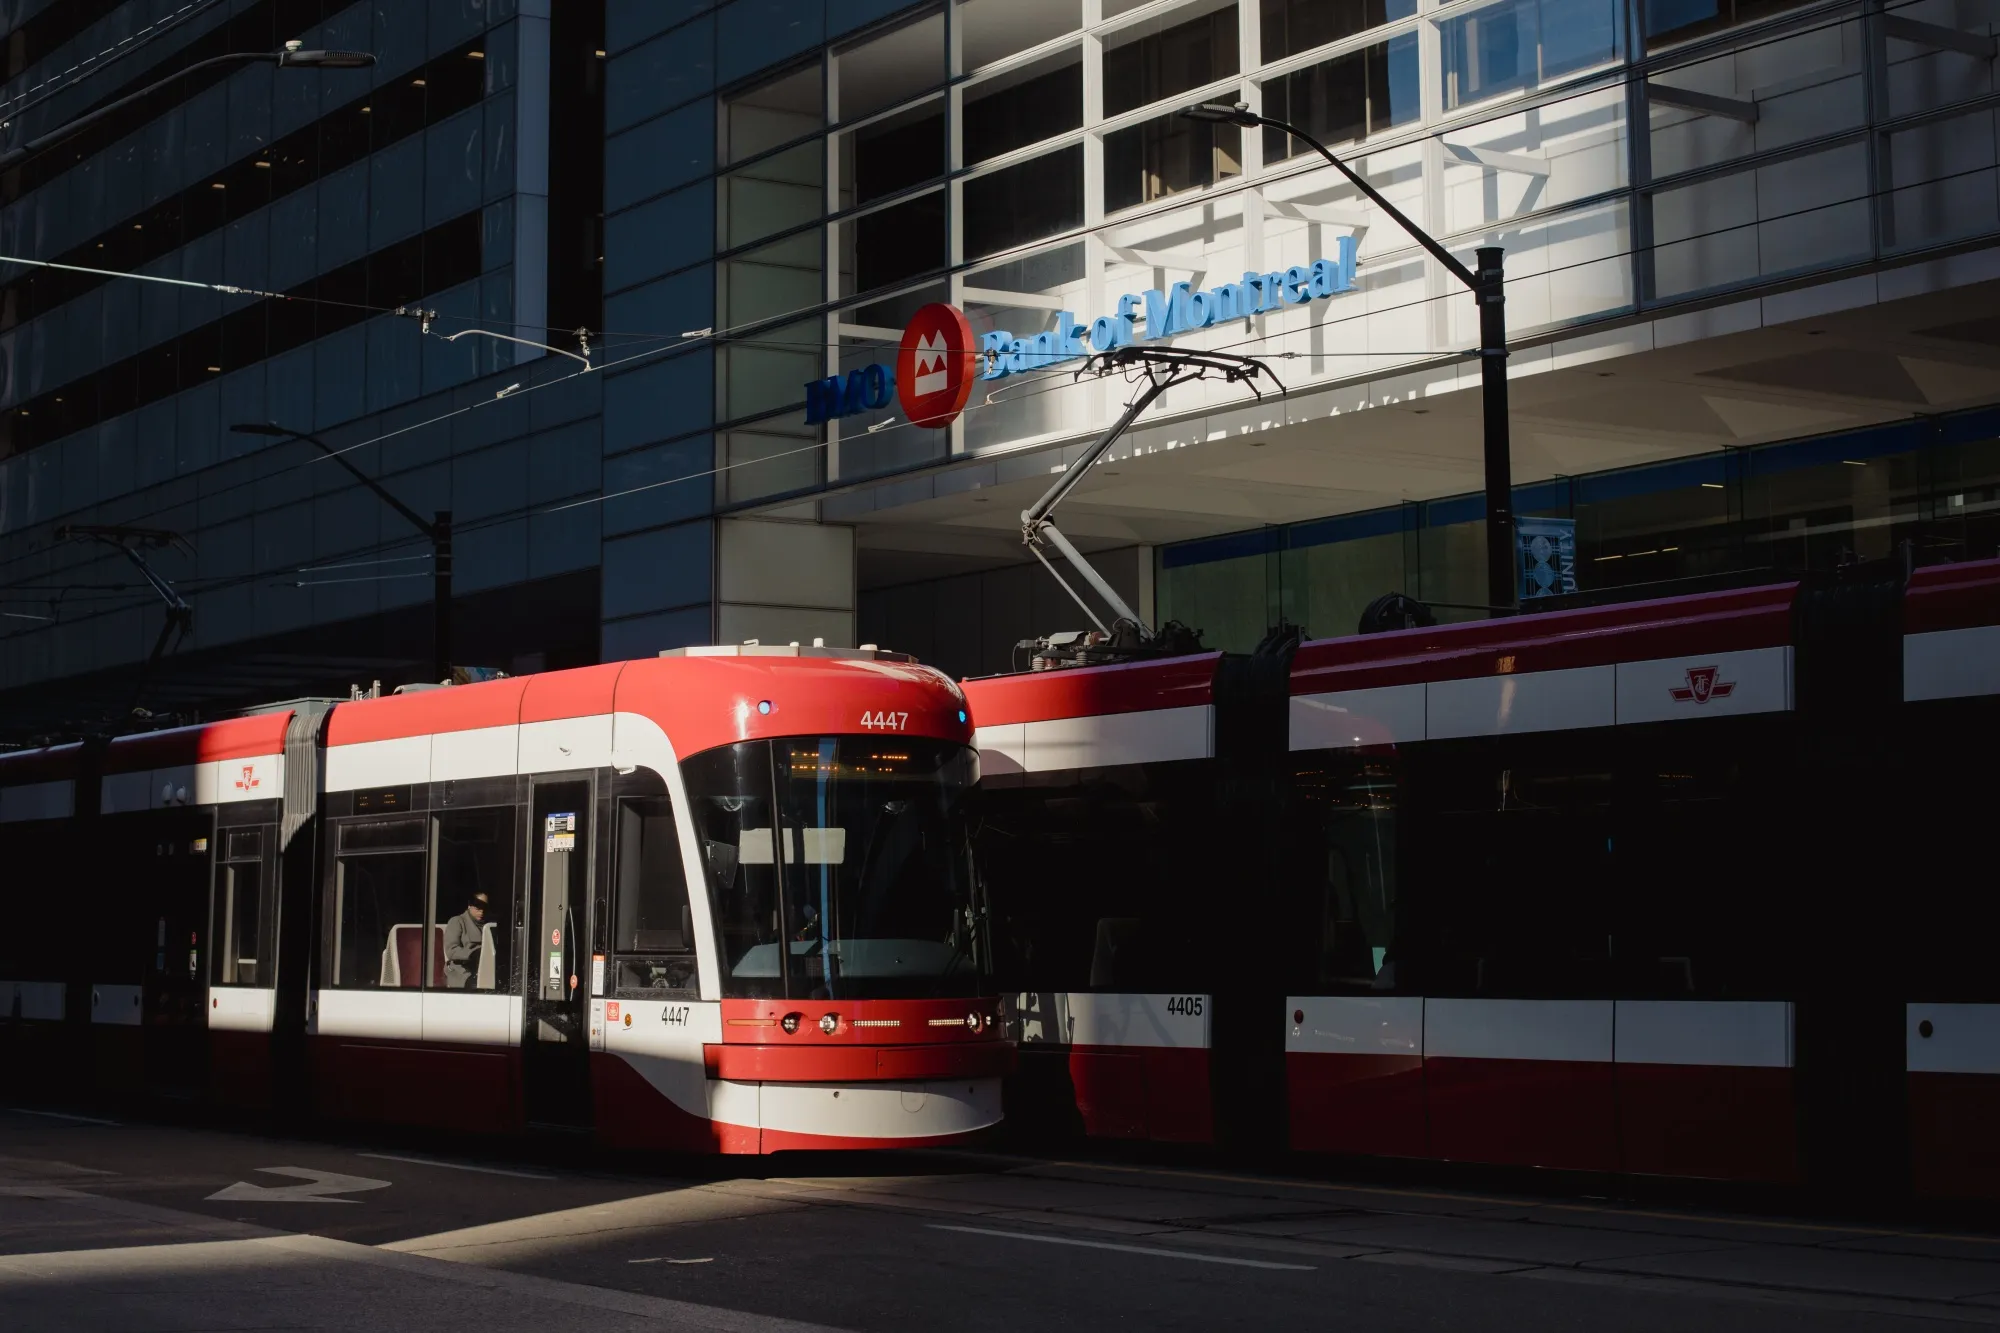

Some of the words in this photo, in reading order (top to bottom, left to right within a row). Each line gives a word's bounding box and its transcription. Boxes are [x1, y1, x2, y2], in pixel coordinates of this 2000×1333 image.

[980, 311, 1088, 380] Bank
[1091, 294, 1141, 351] of
[1142, 235, 1359, 341] Montreal
[1560, 528, 1578, 594] UNITY
[860, 710, 909, 731] 4447
[661, 1005, 690, 1027] 4447
[1167, 996, 1203, 1016] 4405
